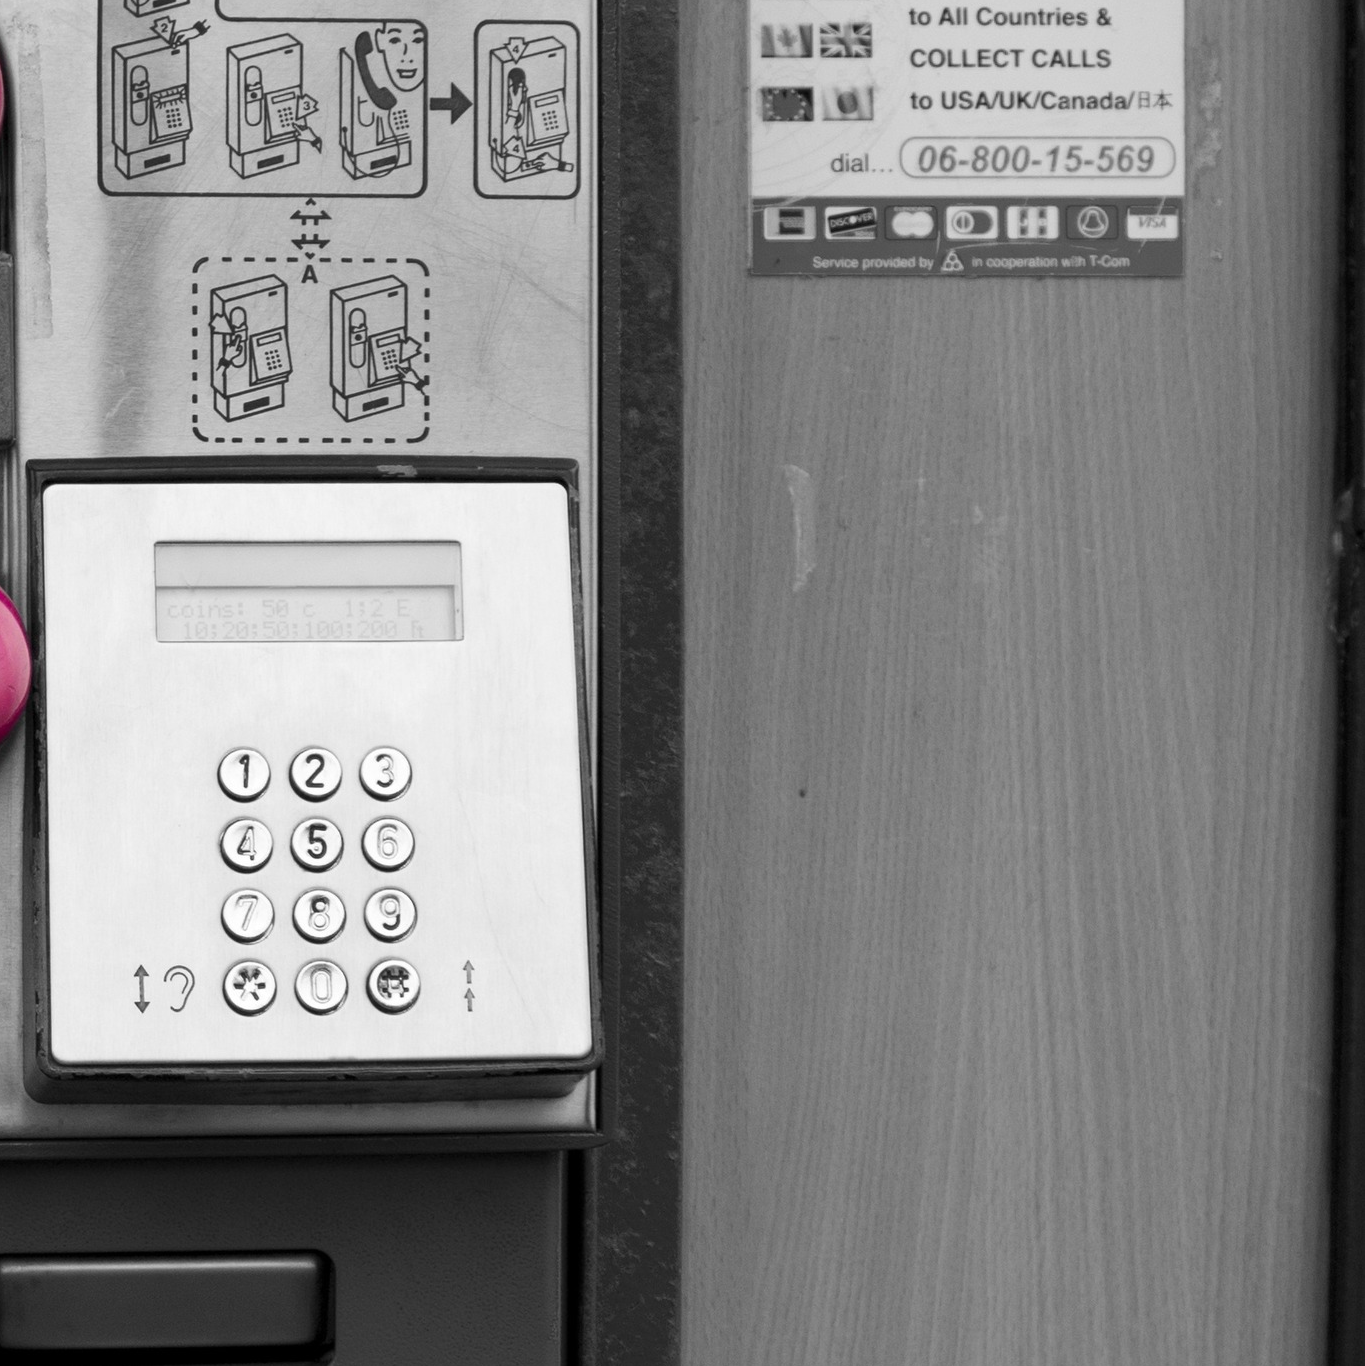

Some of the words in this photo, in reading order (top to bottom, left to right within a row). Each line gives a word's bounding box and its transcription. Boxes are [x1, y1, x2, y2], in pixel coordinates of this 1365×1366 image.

[908, 8, 931, 26] to
[938, 7, 968, 25] All
[975, 7, 1088, 26] Countries
[1095, 7, 1111, 26] &
[909, 48, 1024, 68] COLLECT
[1031, 48, 1111, 68] CALLS
[910, 91, 933, 111] to
[917, 145, 1154, 173] 06-800-15-569
[1137, 215, 1168, 230] VISA
[299, 264, 320, 285] A
[812, 255, 859, 268] Service
[861, 256, 916, 270] provided
[917, 256, 934, 270] by
[971, 256, 983, 267] in
[985, 256, 1058, 269] cooperation
[1060, 255, 1086, 267] with
[1088, 255, 1130, 268] T-Com
[168, 599, 244, 619] coins:
[261, 598, 289, 618] 50
[300, 600, 318, 619] c
[238, 752, 251, 790] 1
[304, 753, 326, 789] 2
[374, 753, 395, 789] 3
[235, 826, 258, 861] 4
[306, 823, 328, 860] 5
[375, 824, 399, 860] 6
[236, 893, 261, 931] 7
[307, 895, 331, 931] 8
[378, 894, 402, 931] 9
[308, 967, 331, 1004] 0
